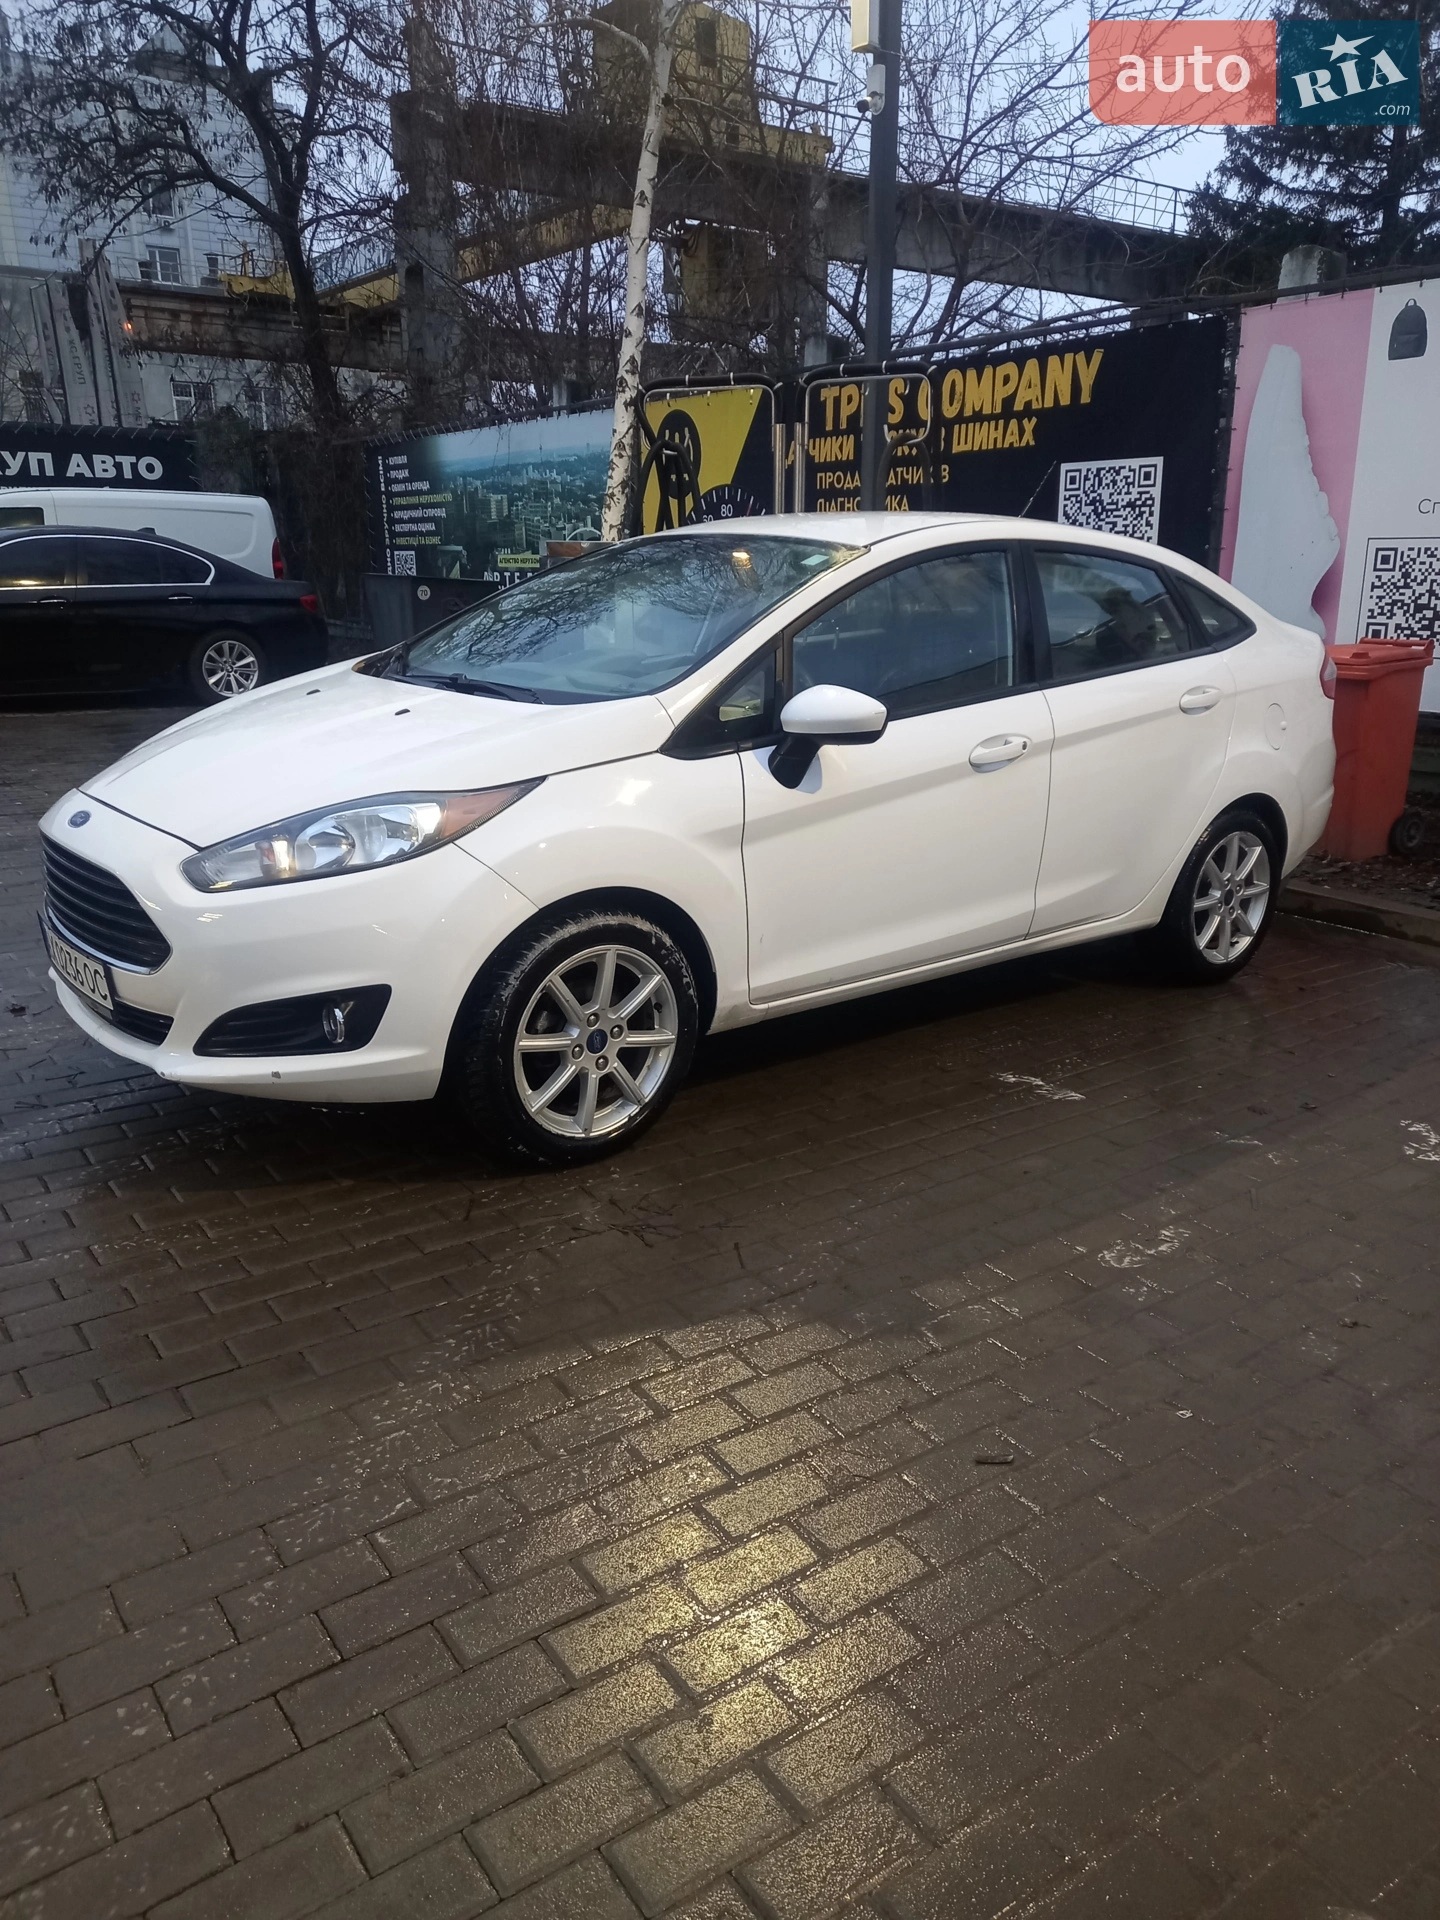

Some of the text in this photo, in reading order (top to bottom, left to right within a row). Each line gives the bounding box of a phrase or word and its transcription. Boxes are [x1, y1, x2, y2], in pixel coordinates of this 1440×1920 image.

[820, 348, 1104, 431] TPS COMPANY
[785, 434, 854, 469] АЧИКИ
[952, 416, 1037, 454] ШИНАХ
[0, 450, 164, 481] УП АВТО
[388, 455, 408, 465] КУПІВЛЯ
[389, 469, 410, 480] ПРОДАЖ
[816, 464, 949, 490] ПРОДА АТЧИВ
[412, 480, 430, 491] ОРЕНДА
[392, 496, 419, 505] УПРАВЛІННЯ
[817, 494, 909, 513] ДІАГНОИКА
[393, 507, 446, 520] ЮРИДИЧНИЙ СУПРОВІД
[720, 503, 733, 517] 80
[382, 494, 390, 546] ЗРУЧНО
[395, 522, 436, 533] ЕКСПЕРТНА ОЦІНКА
[396, 535, 419, 547] ІНВЕСТИЦІЇ
[425, 536, 441, 545] БІЗНЕС
[499, 557, 520, 565] АГЕНСТВО
